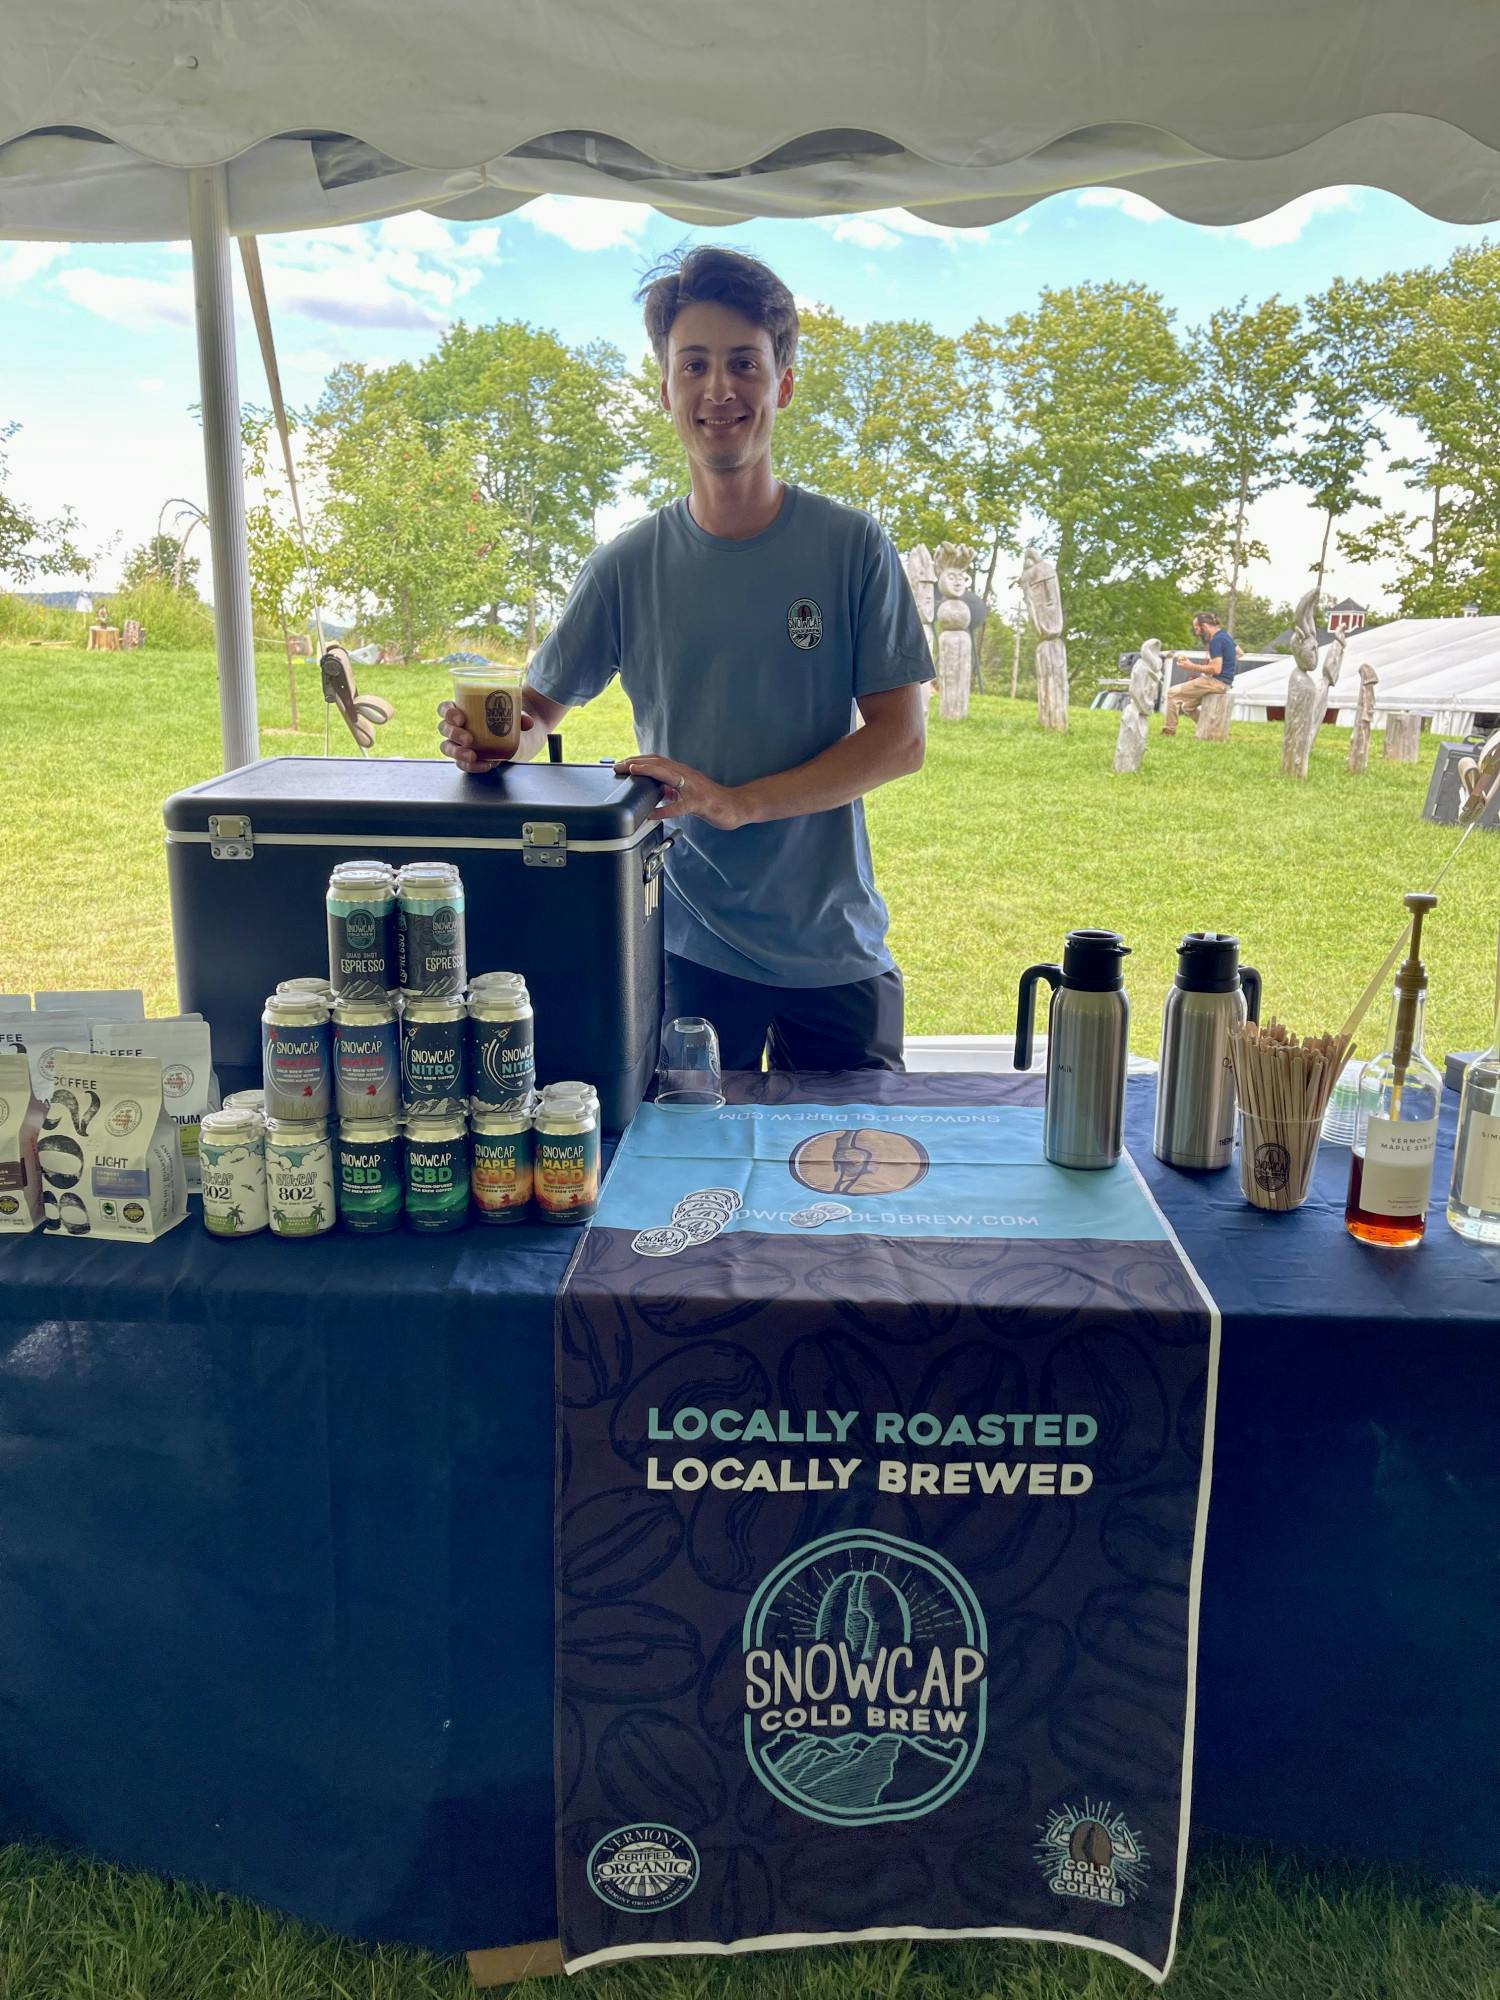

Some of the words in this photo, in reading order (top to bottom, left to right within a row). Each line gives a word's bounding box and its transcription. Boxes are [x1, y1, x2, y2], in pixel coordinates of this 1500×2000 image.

[341, 958, 385, 974] ESPRESSO
[425, 954, 464, 972] ESPRESSO
[276, 1041, 320, 1055] SNOWCAP
[340, 1040, 383, 1054] SNOWCAP
[411, 1049, 456, 1064] SNOWCAP
[411, 1063, 455, 1076] NITRO
[1057, 1063, 1072, 1073] Milk
[53, 1076, 97, 1090] COFFEE
[718, 1111, 1001, 1123] SNOWCAPCOLDBREW.COM
[475, 1143, 516, 1159] SNOWCAP
[542, 1145, 584, 1159] SNOWCAP
[1380, 1143, 1411, 1151] MAPLE
[95, 1155, 129, 1169] LIGHT
[340, 1151, 381, 1168] SNOWCAP
[409, 1152, 452, 1167] SNOWCAP
[475, 1157, 516, 1169] MAPLE
[542, 1158, 584, 1169] MAPLE
[275, 1171, 318, 1187] SNOWCAP
[342, 1166, 382, 1184] CBD
[410, 1166, 453, 1183] CBD
[475, 1167, 516, 1185] CBD
[543, 1168, 584, 1185] CBD
[278, 1186, 313, 1201] 802
[638, 1234, 684, 1246] SNOWCAP
[647, 1406, 859, 1442] LOCALLY
[875, 1412, 1098, 1446] ROASTED
[647, 1457, 862, 1492] LOCALLY
[878, 1460, 1094, 1495] BREWED
[744, 1642, 985, 1710] SNOWCAP
[759, 1704, 852, 1732] COLD
[866, 1706, 968, 1733] BREW
[601, 1829, 684, 1852] VERMONT
[617, 1851, 672, 1861] CERTIFIED
[599, 1861, 689, 1877] ORGANIC
[1064, 1859, 1112, 1877] COLD
[1062, 1869, 1113, 1890] BREW
[603, 1883, 631, 1905] VERMONT
[1053, 1880, 1121, 1902] COFFEE
